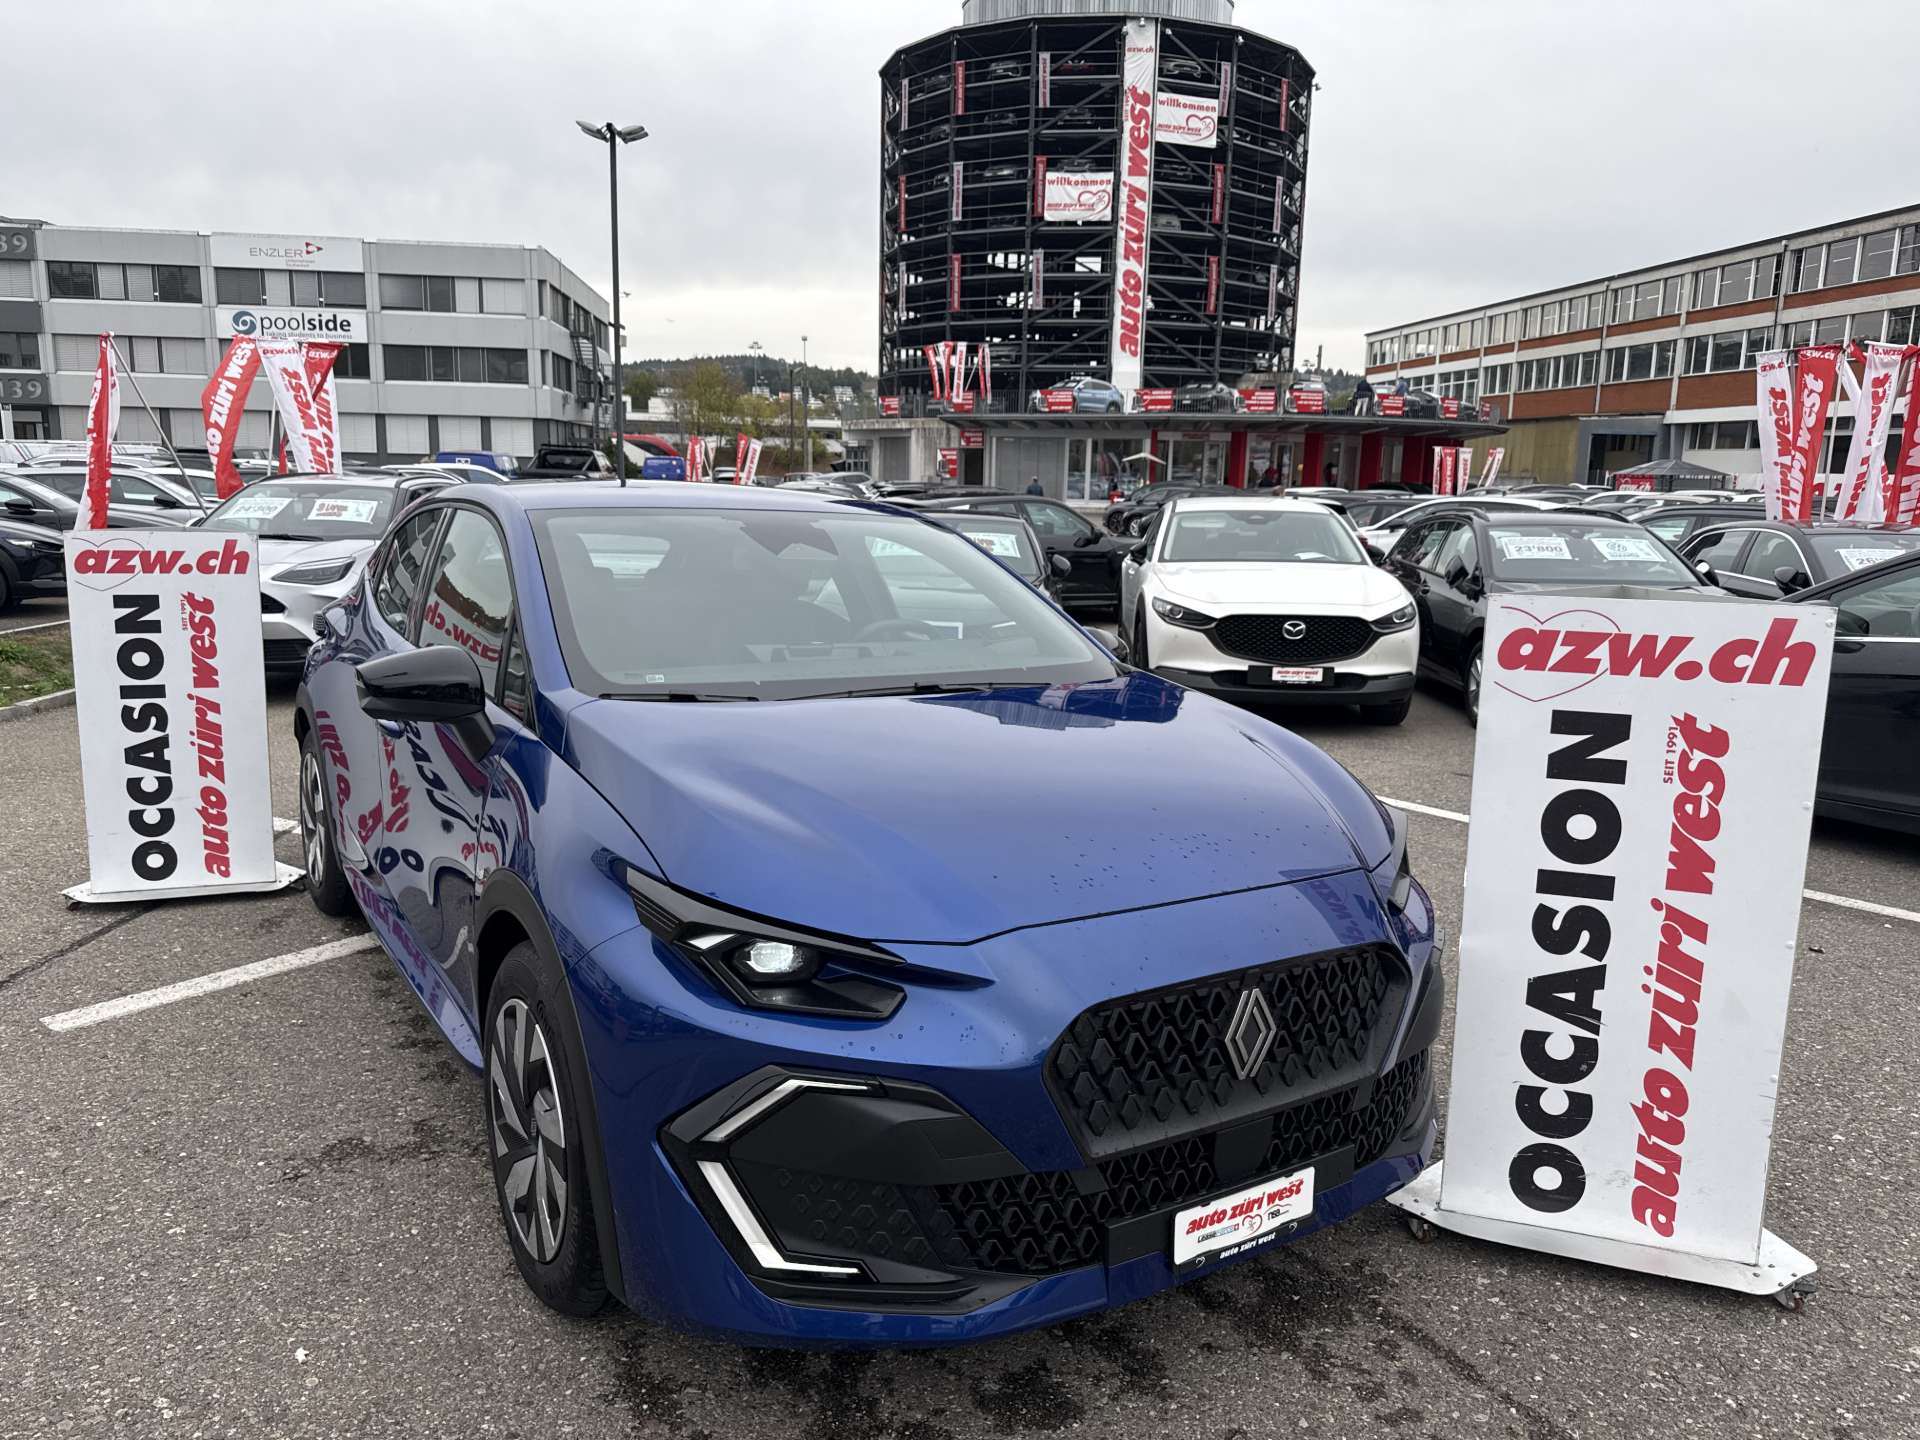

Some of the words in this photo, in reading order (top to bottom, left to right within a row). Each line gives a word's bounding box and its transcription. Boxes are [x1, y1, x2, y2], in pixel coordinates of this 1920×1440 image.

[1126, 84, 1151, 177] west
[1158, 98, 1217, 112] willkommen
[1047, 176, 1112, 187] willkommen
[249, 247, 304, 259] ENZLER
[1119, 181, 1147, 269] züri
[260, 312, 352, 336] poolside
[1118, 268, 1143, 358] auto
[209, 377, 237, 430] züri
[224, 341, 256, 379] west
[280, 367, 318, 430] west
[1768, 386, 1792, 457] west
[1796, 372, 1824, 450] west
[302, 432, 329, 473] üri
[74, 539, 250, 576] azw.ch
[180, 592, 219, 690] west
[1497, 618, 1817, 688] azw.ch
[113, 594, 178, 882] OCCASION
[186, 692, 226, 785] züri
[1663, 759, 1676, 785] SEIT
[1666, 726, 1679, 754] 1991
[195, 785, 231, 879] auto
[1664, 711, 1730, 897] west
[1508, 709, 1633, 1214] OCCASION
[1641, 896, 1711, 1072] züri
[1630, 1066, 1691, 1239] auto
[1186, 1208, 1228, 1235] auto
[1228, 1192, 1266, 1220] züri
[1267, 1178, 1304, 1206] west
[1220, 1245, 1239, 1259] auto
[1240, 1239, 1257, 1252] züri
[1258, 1232, 1277, 1246] west
